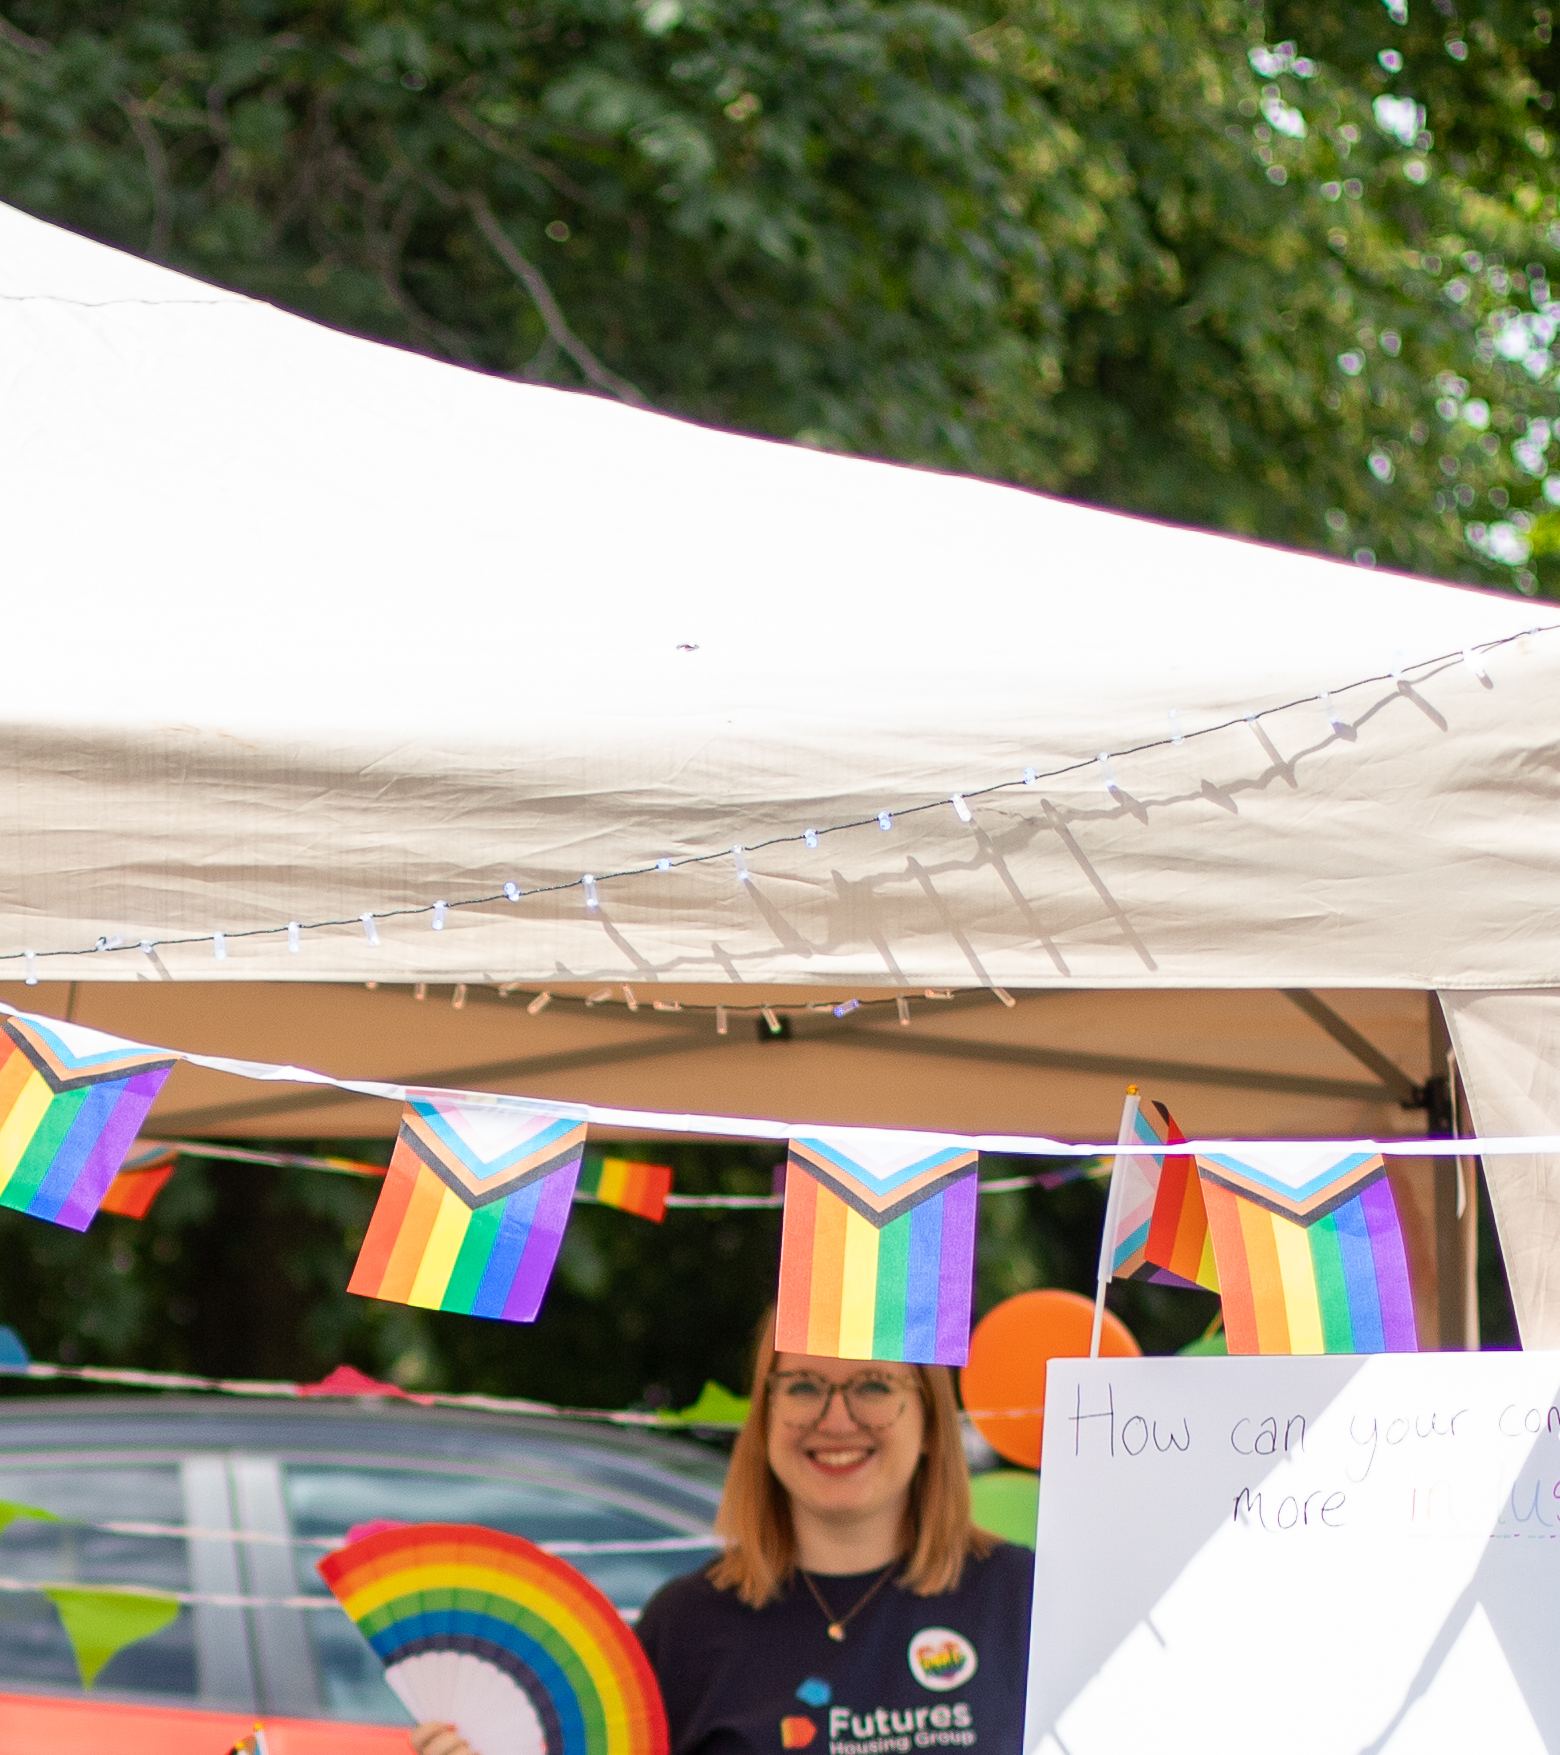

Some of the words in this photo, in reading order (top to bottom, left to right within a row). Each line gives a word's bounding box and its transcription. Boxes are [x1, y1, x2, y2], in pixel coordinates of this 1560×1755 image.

[1068, 1383, 1190, 1457] How
[1231, 1414, 1306, 1455] can
[1345, 1408, 1468, 1483] your
[1232, 1487, 1345, 1532] more
[830, 1703, 972, 1739] Futures
[914, 1730, 976, 1748] Group
